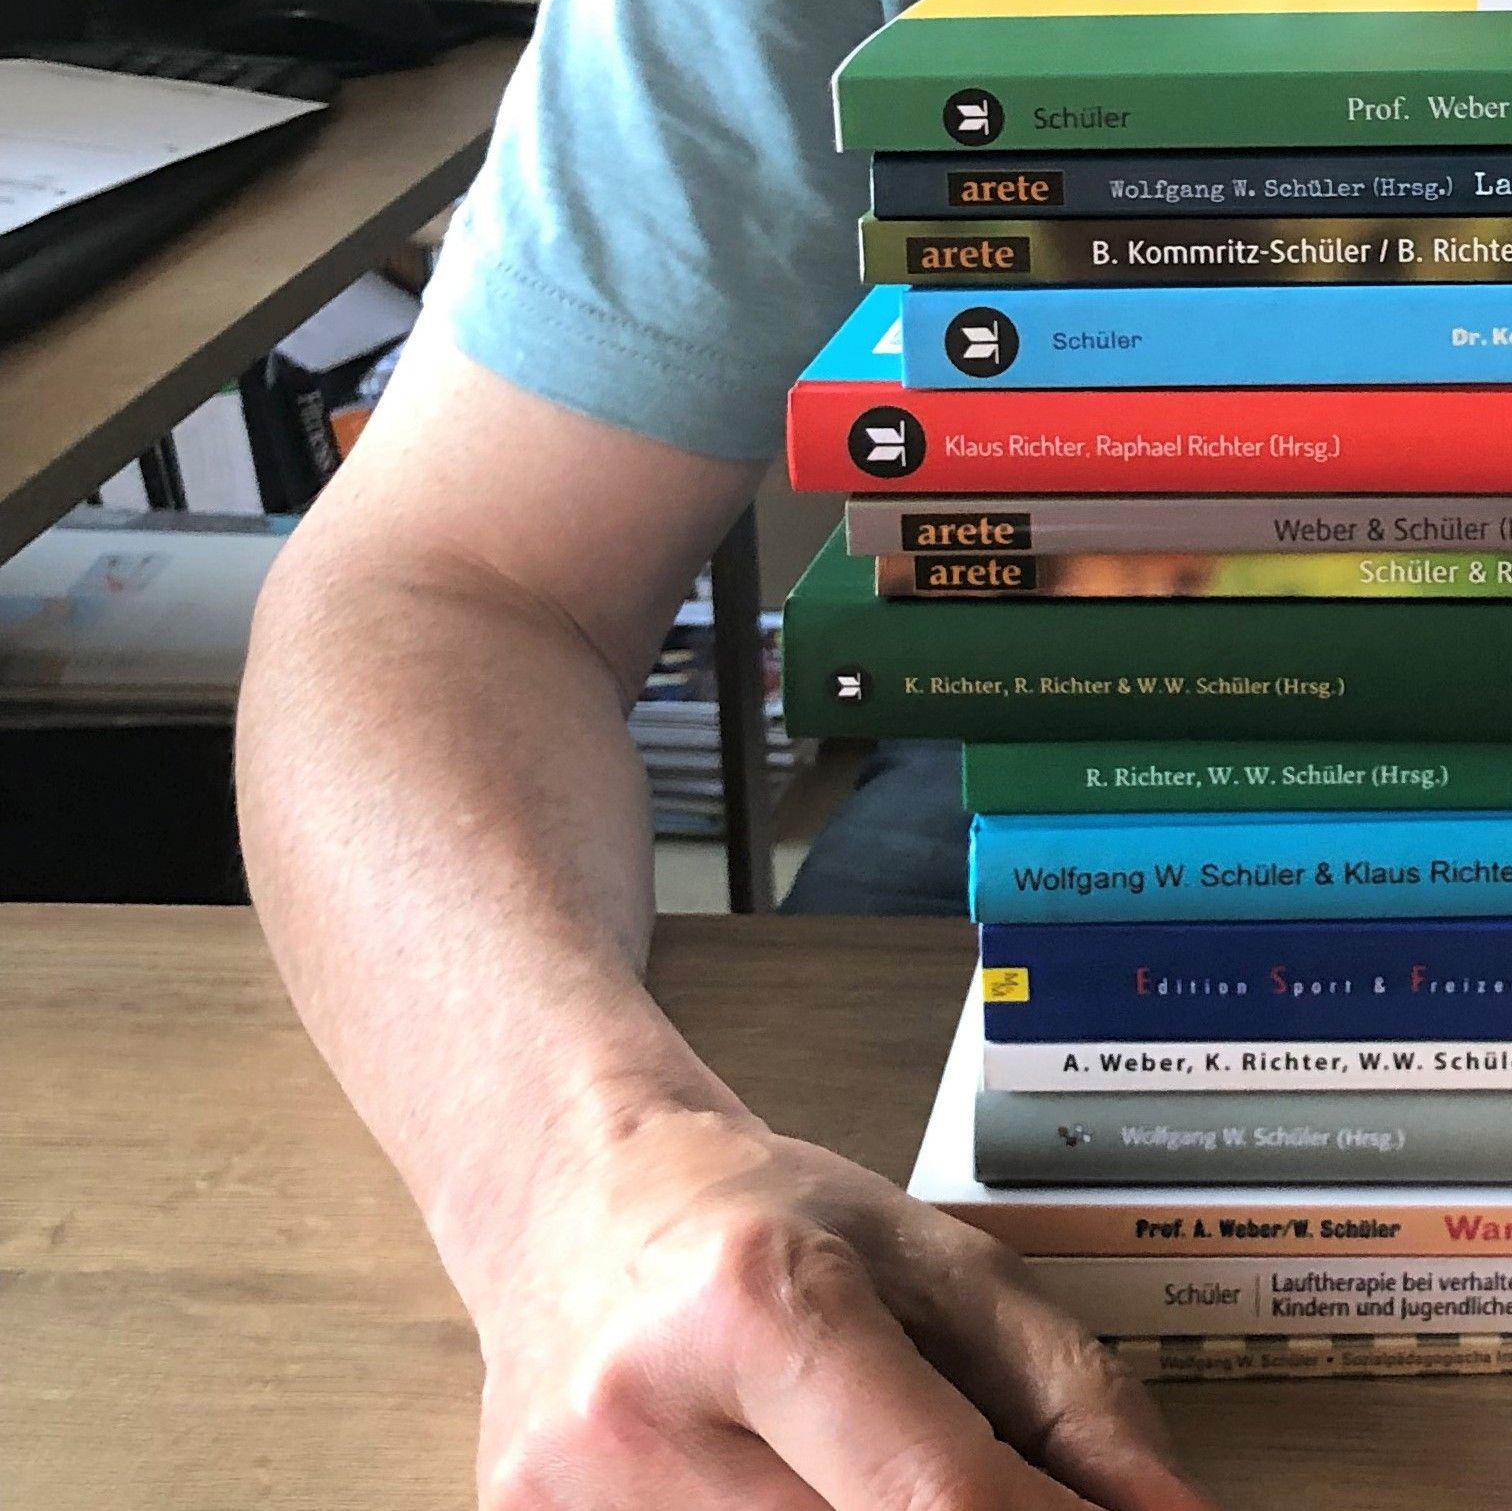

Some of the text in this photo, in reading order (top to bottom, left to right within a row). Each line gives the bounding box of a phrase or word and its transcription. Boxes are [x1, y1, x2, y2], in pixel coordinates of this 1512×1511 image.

[1034, 106, 1131, 129] Schüler
[1349, 96, 1409, 120] Prof.
[1428, 95, 1510, 118] Weber
[962, 176, 1048, 201] arete
[1110, 176, 1452, 203] Wolfgang W. Schüler (Hrsg.)
[921, 240, 1014, 270] arete
[1093, 241, 1117, 264] B.
[1129, 238, 1371, 264] Kommritz-Schüler
[1380, 239, 1388, 262] /
[1399, 239, 1422, 262] B.
[1053, 331, 1142, 350] Schüler
[1452, 328, 1487, 346] Dr.
[945, 434, 1339, 462] Klaus Richter, Raphael Richter (Hrsg.)
[917, 518, 1014, 546] arete
[1274, 518, 1357, 542] Weber
[1367, 518, 1384, 541] &
[1395, 517, 1489, 541] Schüler
[930, 560, 1021, 585] arete
[1360, 559, 1459, 583] Schüler
[1469, 561, 1486, 584] &
[905, 678, 923, 693] K.
[930, 677, 1008, 696] Richter,
[1015, 678, 1033, 693] R.
[1041, 677, 1112, 694] Richter
[1118, 678, 1130, 694] &
[1197, 678, 1270, 694] Schüler
[1275, 678, 1344, 698] (Hrsg.)
[1087, 764, 1448, 789] R. Richter, W. W. Schüler (Hrsg.)
[1014, 866, 1147, 895] Wolfgang
[1157, 862, 1190, 890] W.
[1200, 858, 1306, 888] Schüler
[1315, 862, 1333, 885] &
[1345, 861, 1423, 884] Klaus
[1138, 969, 1247, 995] Edition
[1270, 967, 1352, 996] Sport
[1064, 1054, 1088, 1072] A.
[1100, 1053, 1192, 1074] Weber,
[1206, 1053, 1229, 1070] K.
[1243, 1052, 1347, 1073] Richter,
[1359, 1053, 1422, 1070] W.W.
[1120, 1126, 1405, 1152] Wolfgang W. Schüler (Hrsg.)
[1136, 1219, 1185, 1238] Prof.
[1194, 1219, 1211, 1238] A.
[1321, 1219, 1401, 1239] Schüler
[1165, 1283, 1240, 1306] Schüler
[1272, 1272, 1396, 1297] Lauftherapie
[1403, 1273, 1432, 1291] bei
[1272, 1297, 1349, 1316] Kindern
[1357, 1297, 1398, 1316] und
